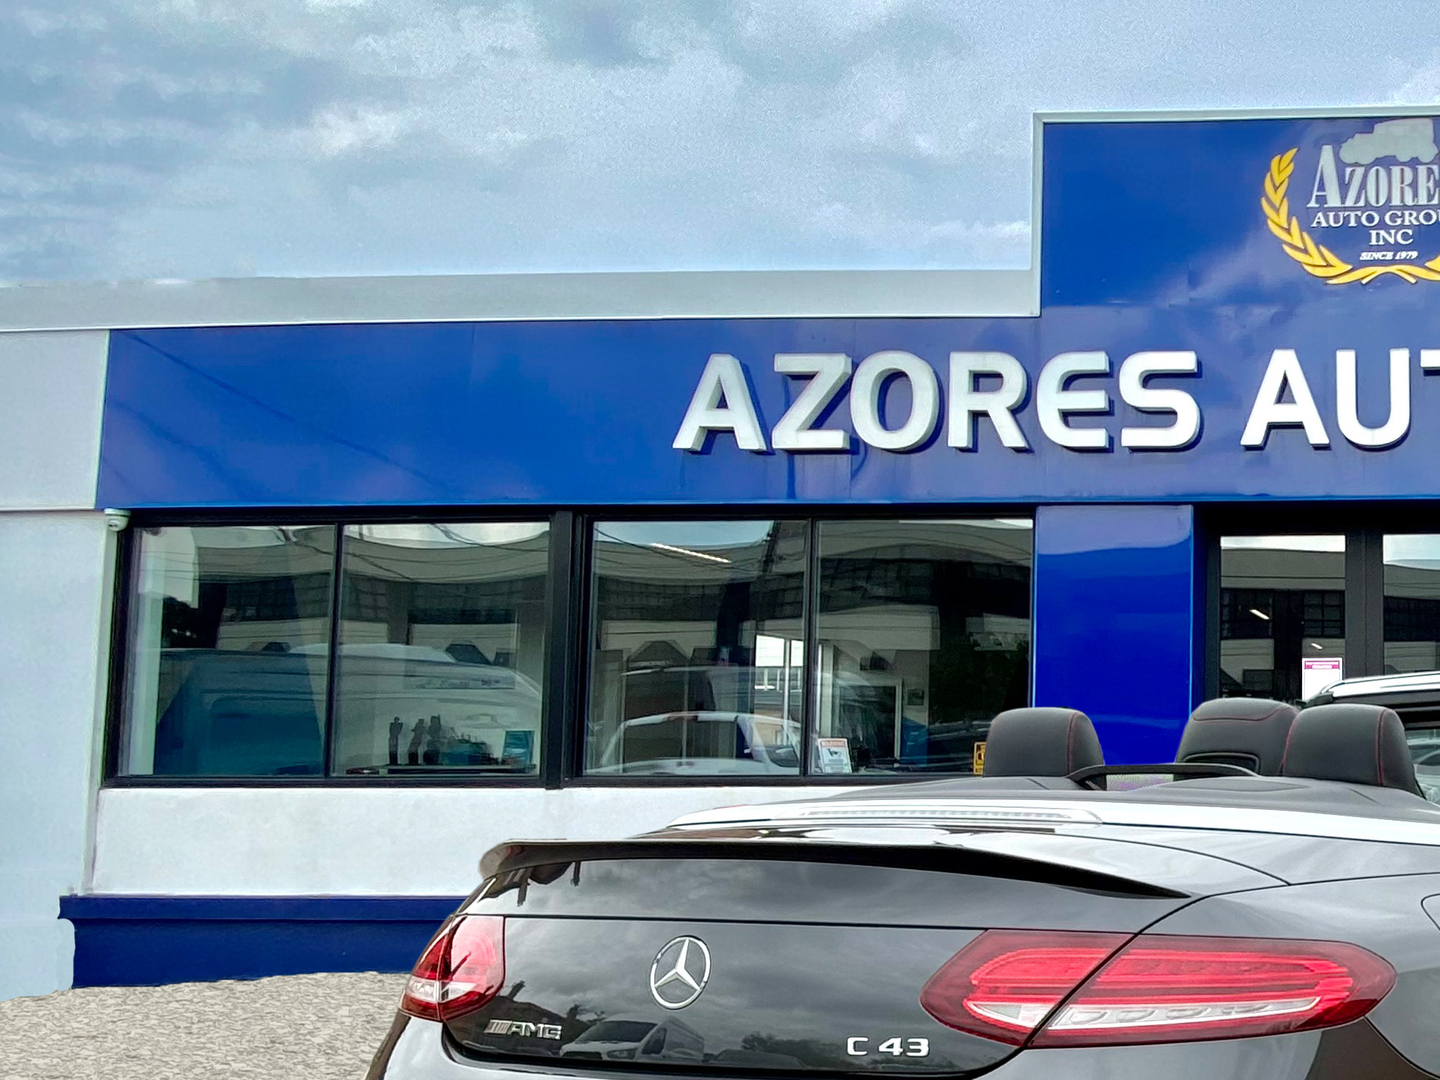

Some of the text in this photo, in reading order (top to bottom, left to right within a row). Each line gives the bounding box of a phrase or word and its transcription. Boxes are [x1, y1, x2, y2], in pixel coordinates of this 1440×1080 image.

[1311, 210, 1380, 228] AUTO
[1369, 229, 1414, 246] INC
[1359, 250, 1418, 260] SINCE 1979
[671, 348, 1203, 454] AZORES
[507, 1020, 563, 1040] AMG
[846, 1036, 930, 1057] C 43
